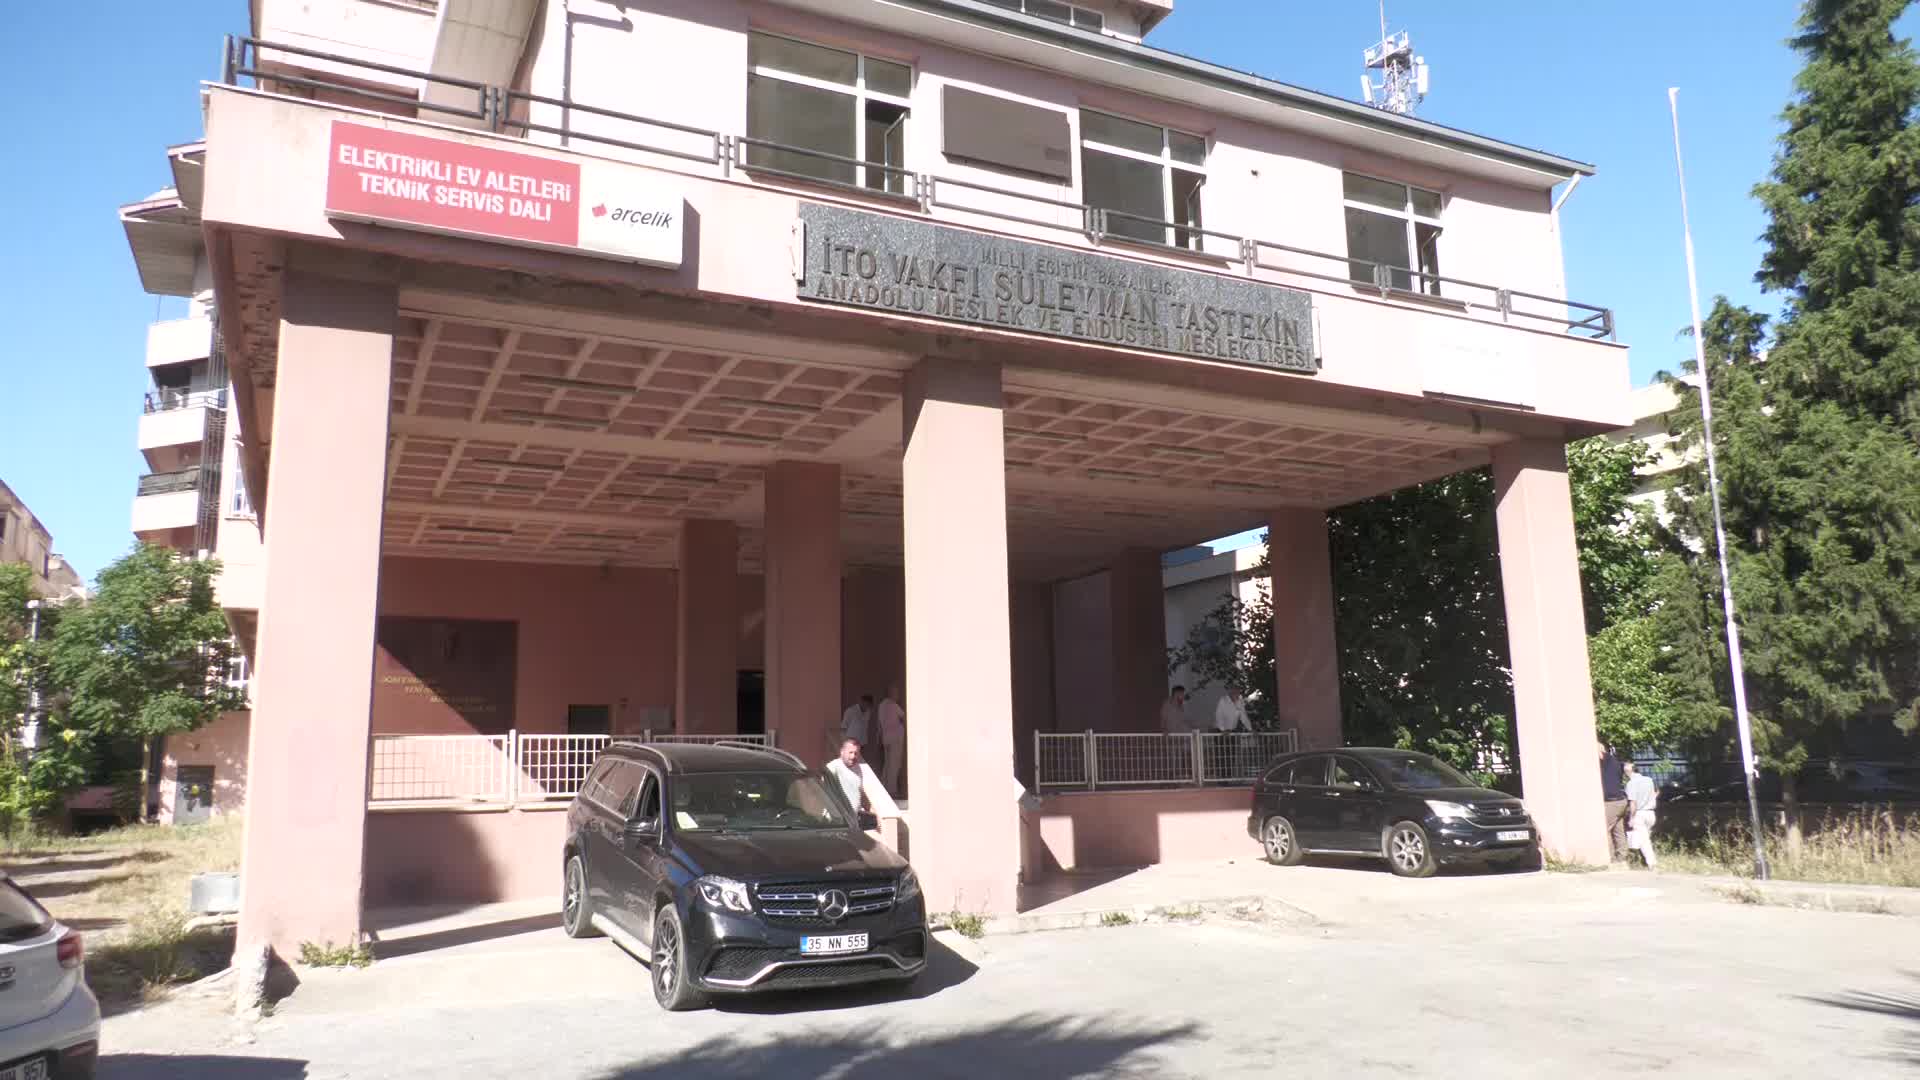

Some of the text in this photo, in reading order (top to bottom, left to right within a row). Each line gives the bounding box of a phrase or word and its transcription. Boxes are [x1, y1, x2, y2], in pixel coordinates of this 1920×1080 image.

[338, 143, 572, 203] ELEKTRİKLİ EV ALETLERİ
[358, 171, 552, 222] TEKNİK SERVİS DALI
[822, 235, 877, 280] İTO
[888, 252, 981, 298] VAKFI
[815, 277, 925, 312] ANADOLU
[935, 291, 1025, 327] MESLEK
[1178, 333, 1250, 361] MESLEK
[808, 934, 866, 950] 35 NN 555
